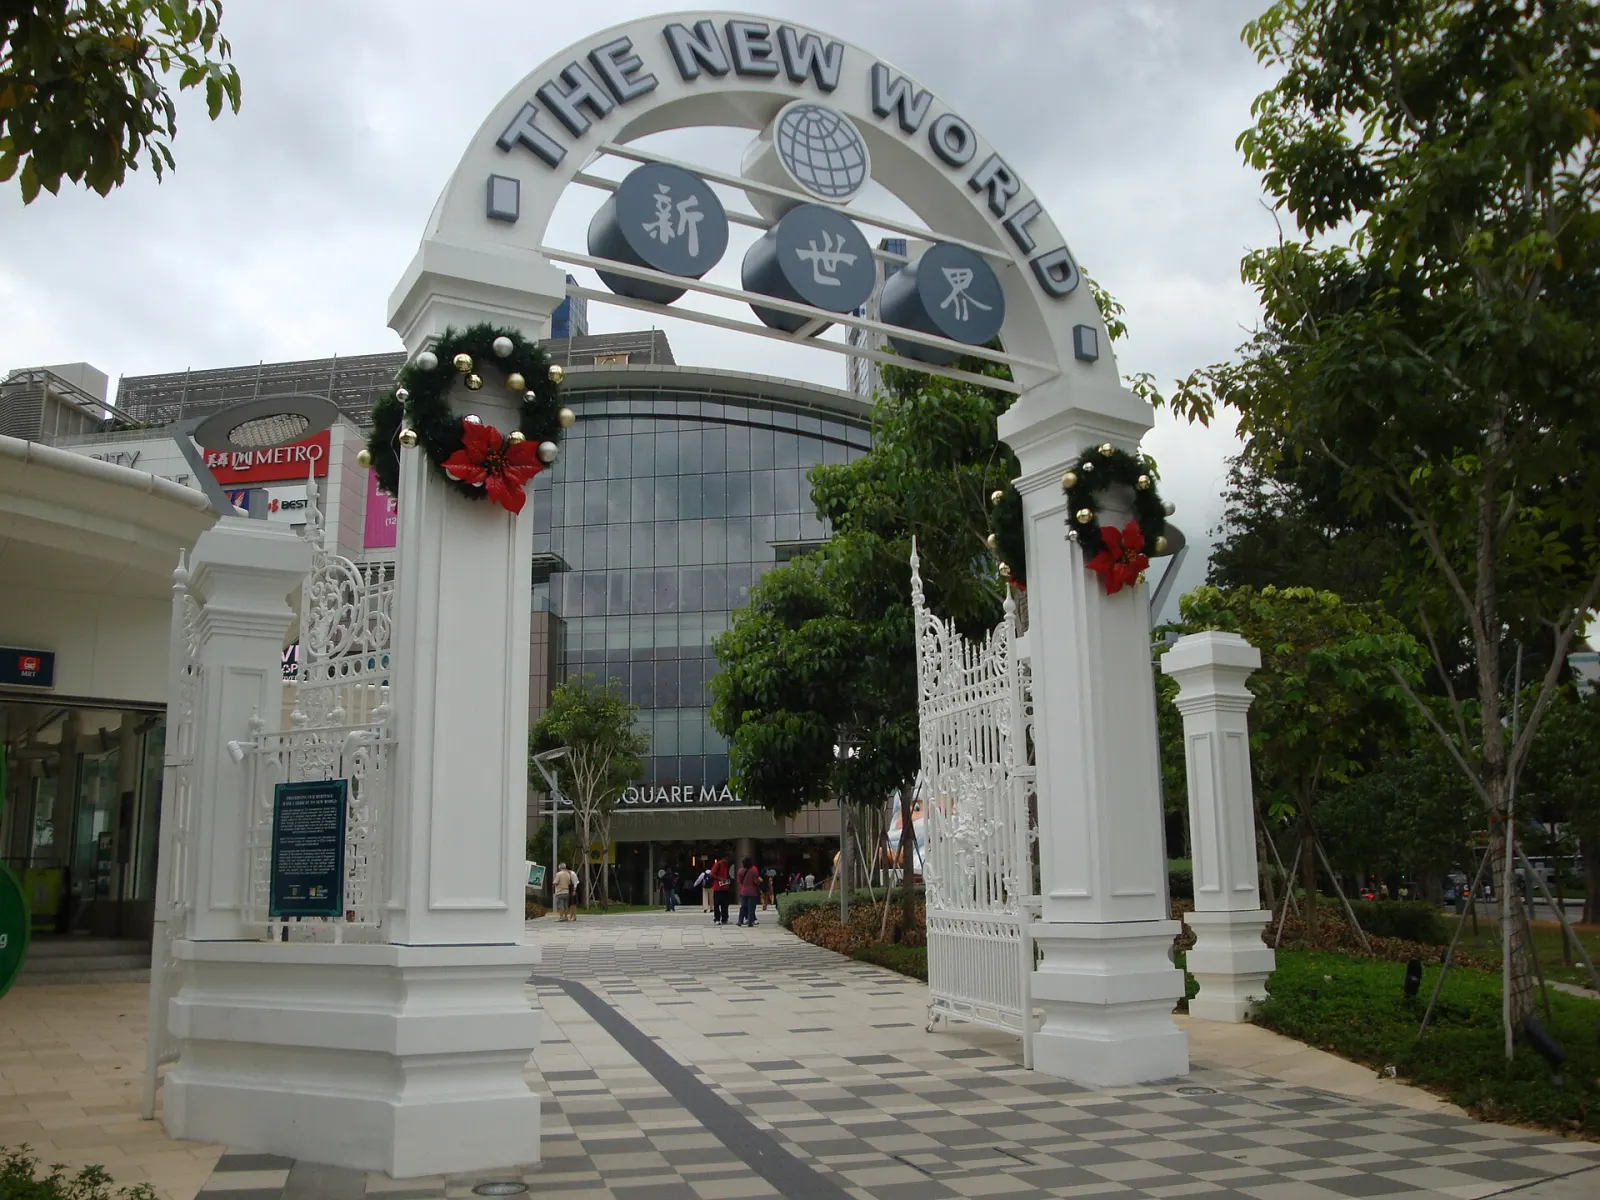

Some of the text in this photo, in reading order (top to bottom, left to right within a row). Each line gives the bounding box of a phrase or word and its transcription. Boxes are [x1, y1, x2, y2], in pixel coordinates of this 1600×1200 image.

[495, 19, 1080, 299] THE NEW WORLD
[642, 183, 993, 322] 新世界
[256, 444, 323, 465] METRO
[613, 785, 694, 804] QUARE
